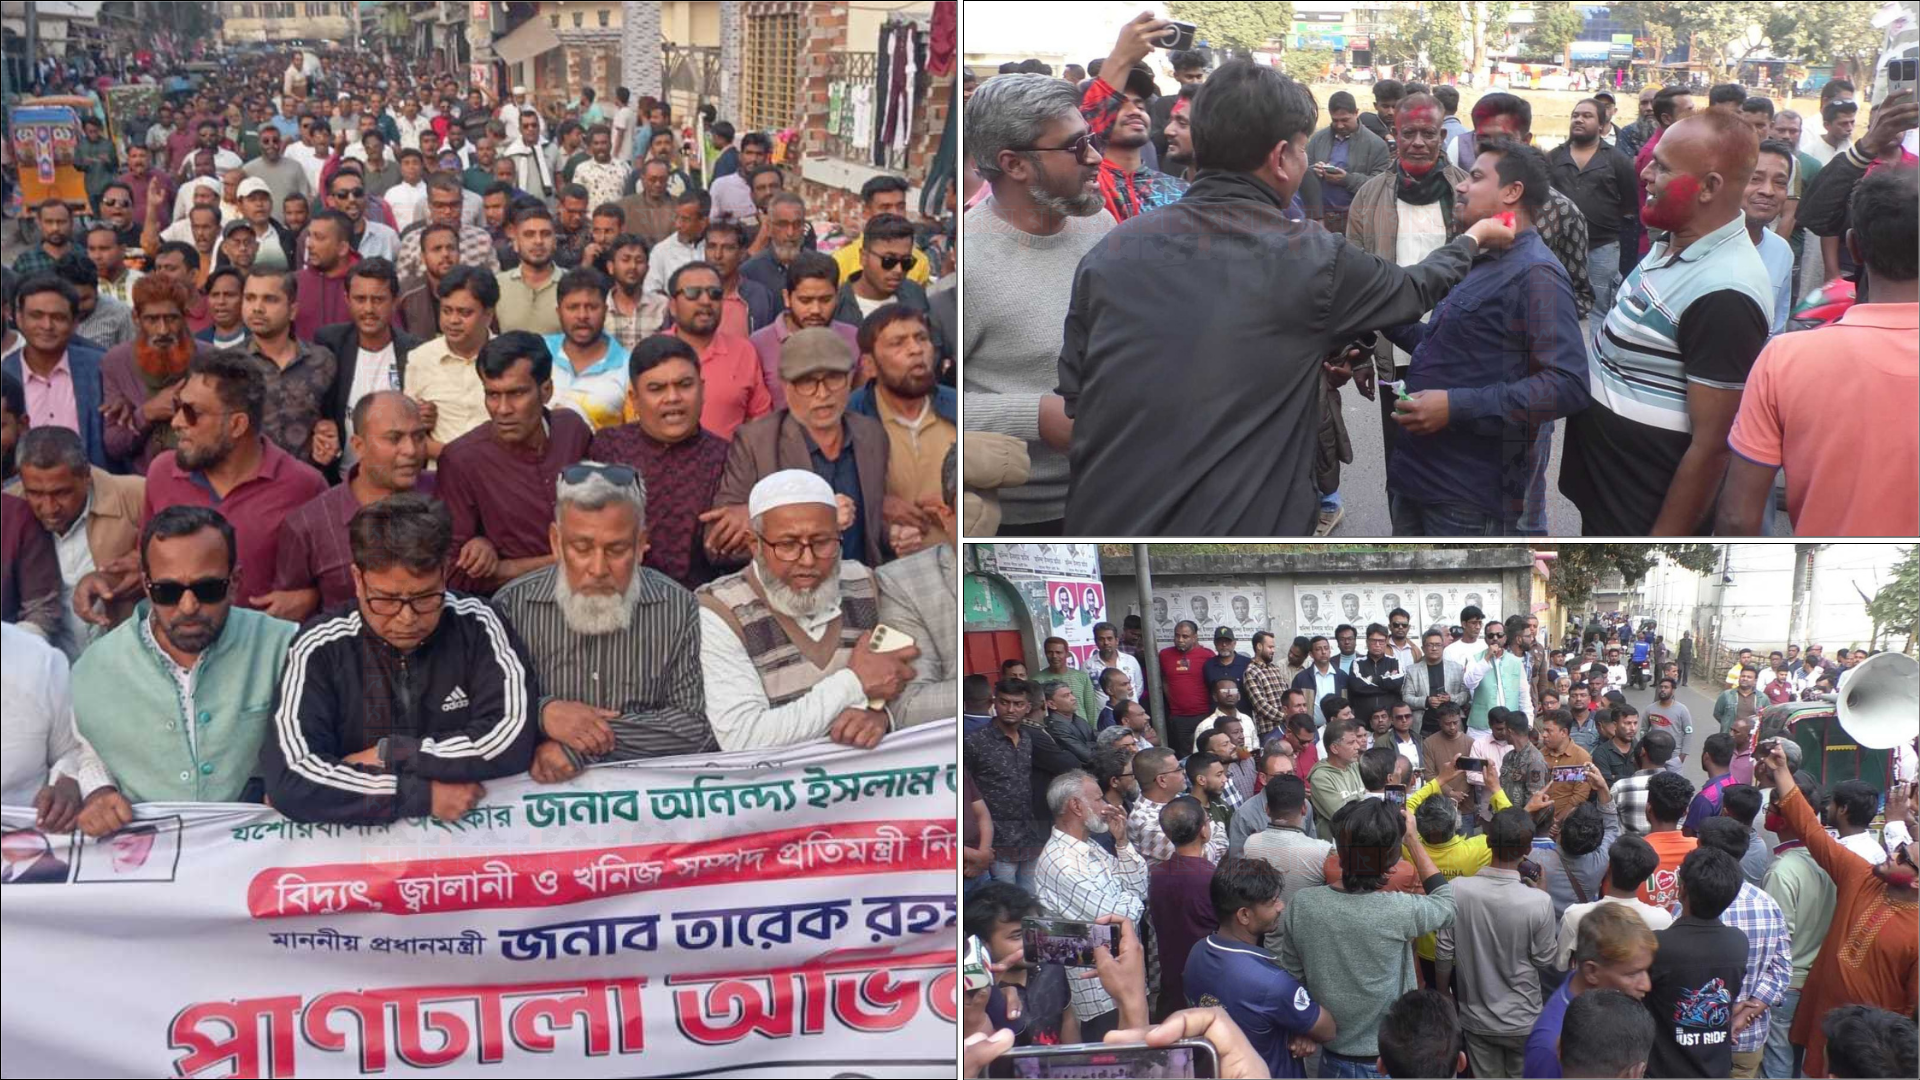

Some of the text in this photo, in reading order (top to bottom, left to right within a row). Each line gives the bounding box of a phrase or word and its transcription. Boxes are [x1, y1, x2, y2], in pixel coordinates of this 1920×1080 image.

[523, 789, 640, 828] জনাব
[646, 774, 797, 820] অনিন্দ্য
[803, 764, 940, 810] ইসলাম
[396, 861, 520, 913] জ্বালানী
[531, 870, 558, 896] ও
[573, 853, 663, 893] খনিজ
[671, 847, 770, 878] সম্পদ
[776, 825, 911, 870] প্রতিমন্ত্রী
[918, 825, 956, 861] নি
[269, 928, 362, 952] মাননীয়
[370, 929, 487, 956] প্রধানমন্ত্রী
[498, 914, 660, 961] জনাব
[670, 899, 852, 950] তারেক
